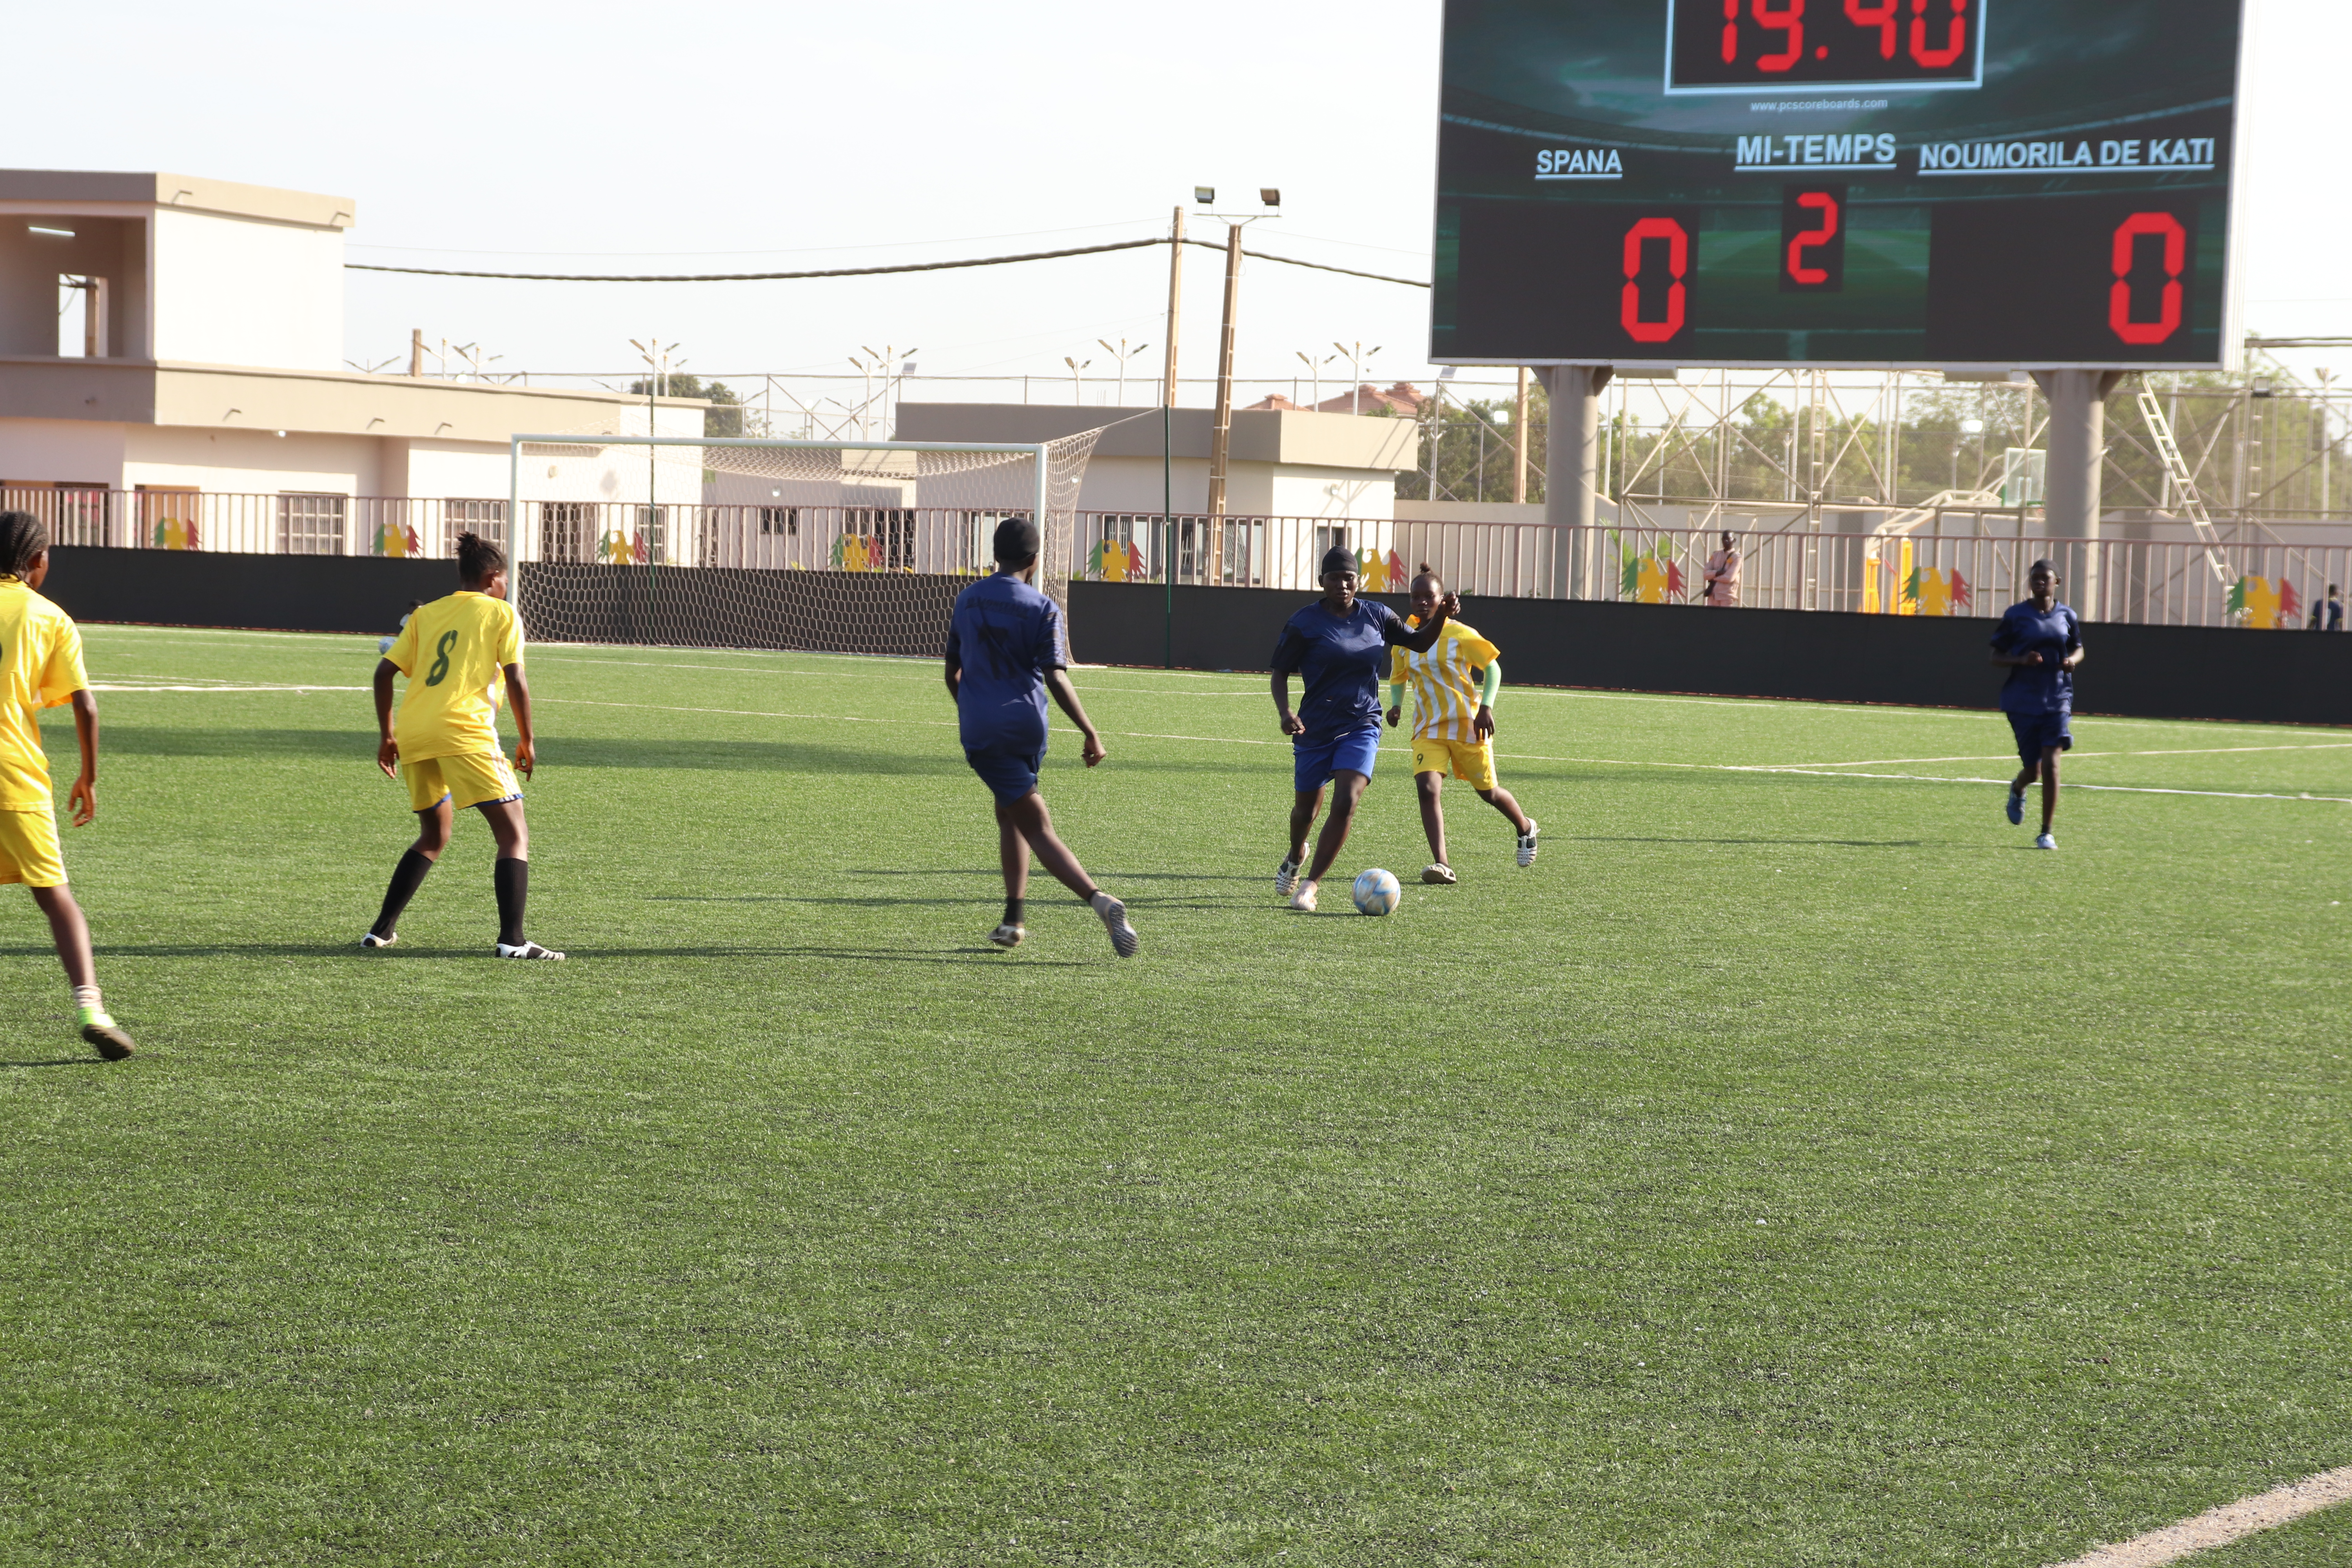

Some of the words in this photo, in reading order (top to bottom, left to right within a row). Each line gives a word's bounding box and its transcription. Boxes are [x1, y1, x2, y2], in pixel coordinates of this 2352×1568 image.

[1750, 98, 1888, 112] www.pcscoreboards.com
[1536, 149, 1623, 172] SPANA
[1737, 133, 1896, 164] MI-TEMPS
[1920, 140, 2093, 169] NOUMORILA
[2099, 139, 2141, 165] DE
[2147, 137, 2216, 164] KATI
[1788, 193, 1837, 283] 2
[1621, 218, 1688, 343] 0
[2109, 213, 2185, 344] 0
[425, 630, 458, 686] 8
[1417, 753, 1424, 765] 9
